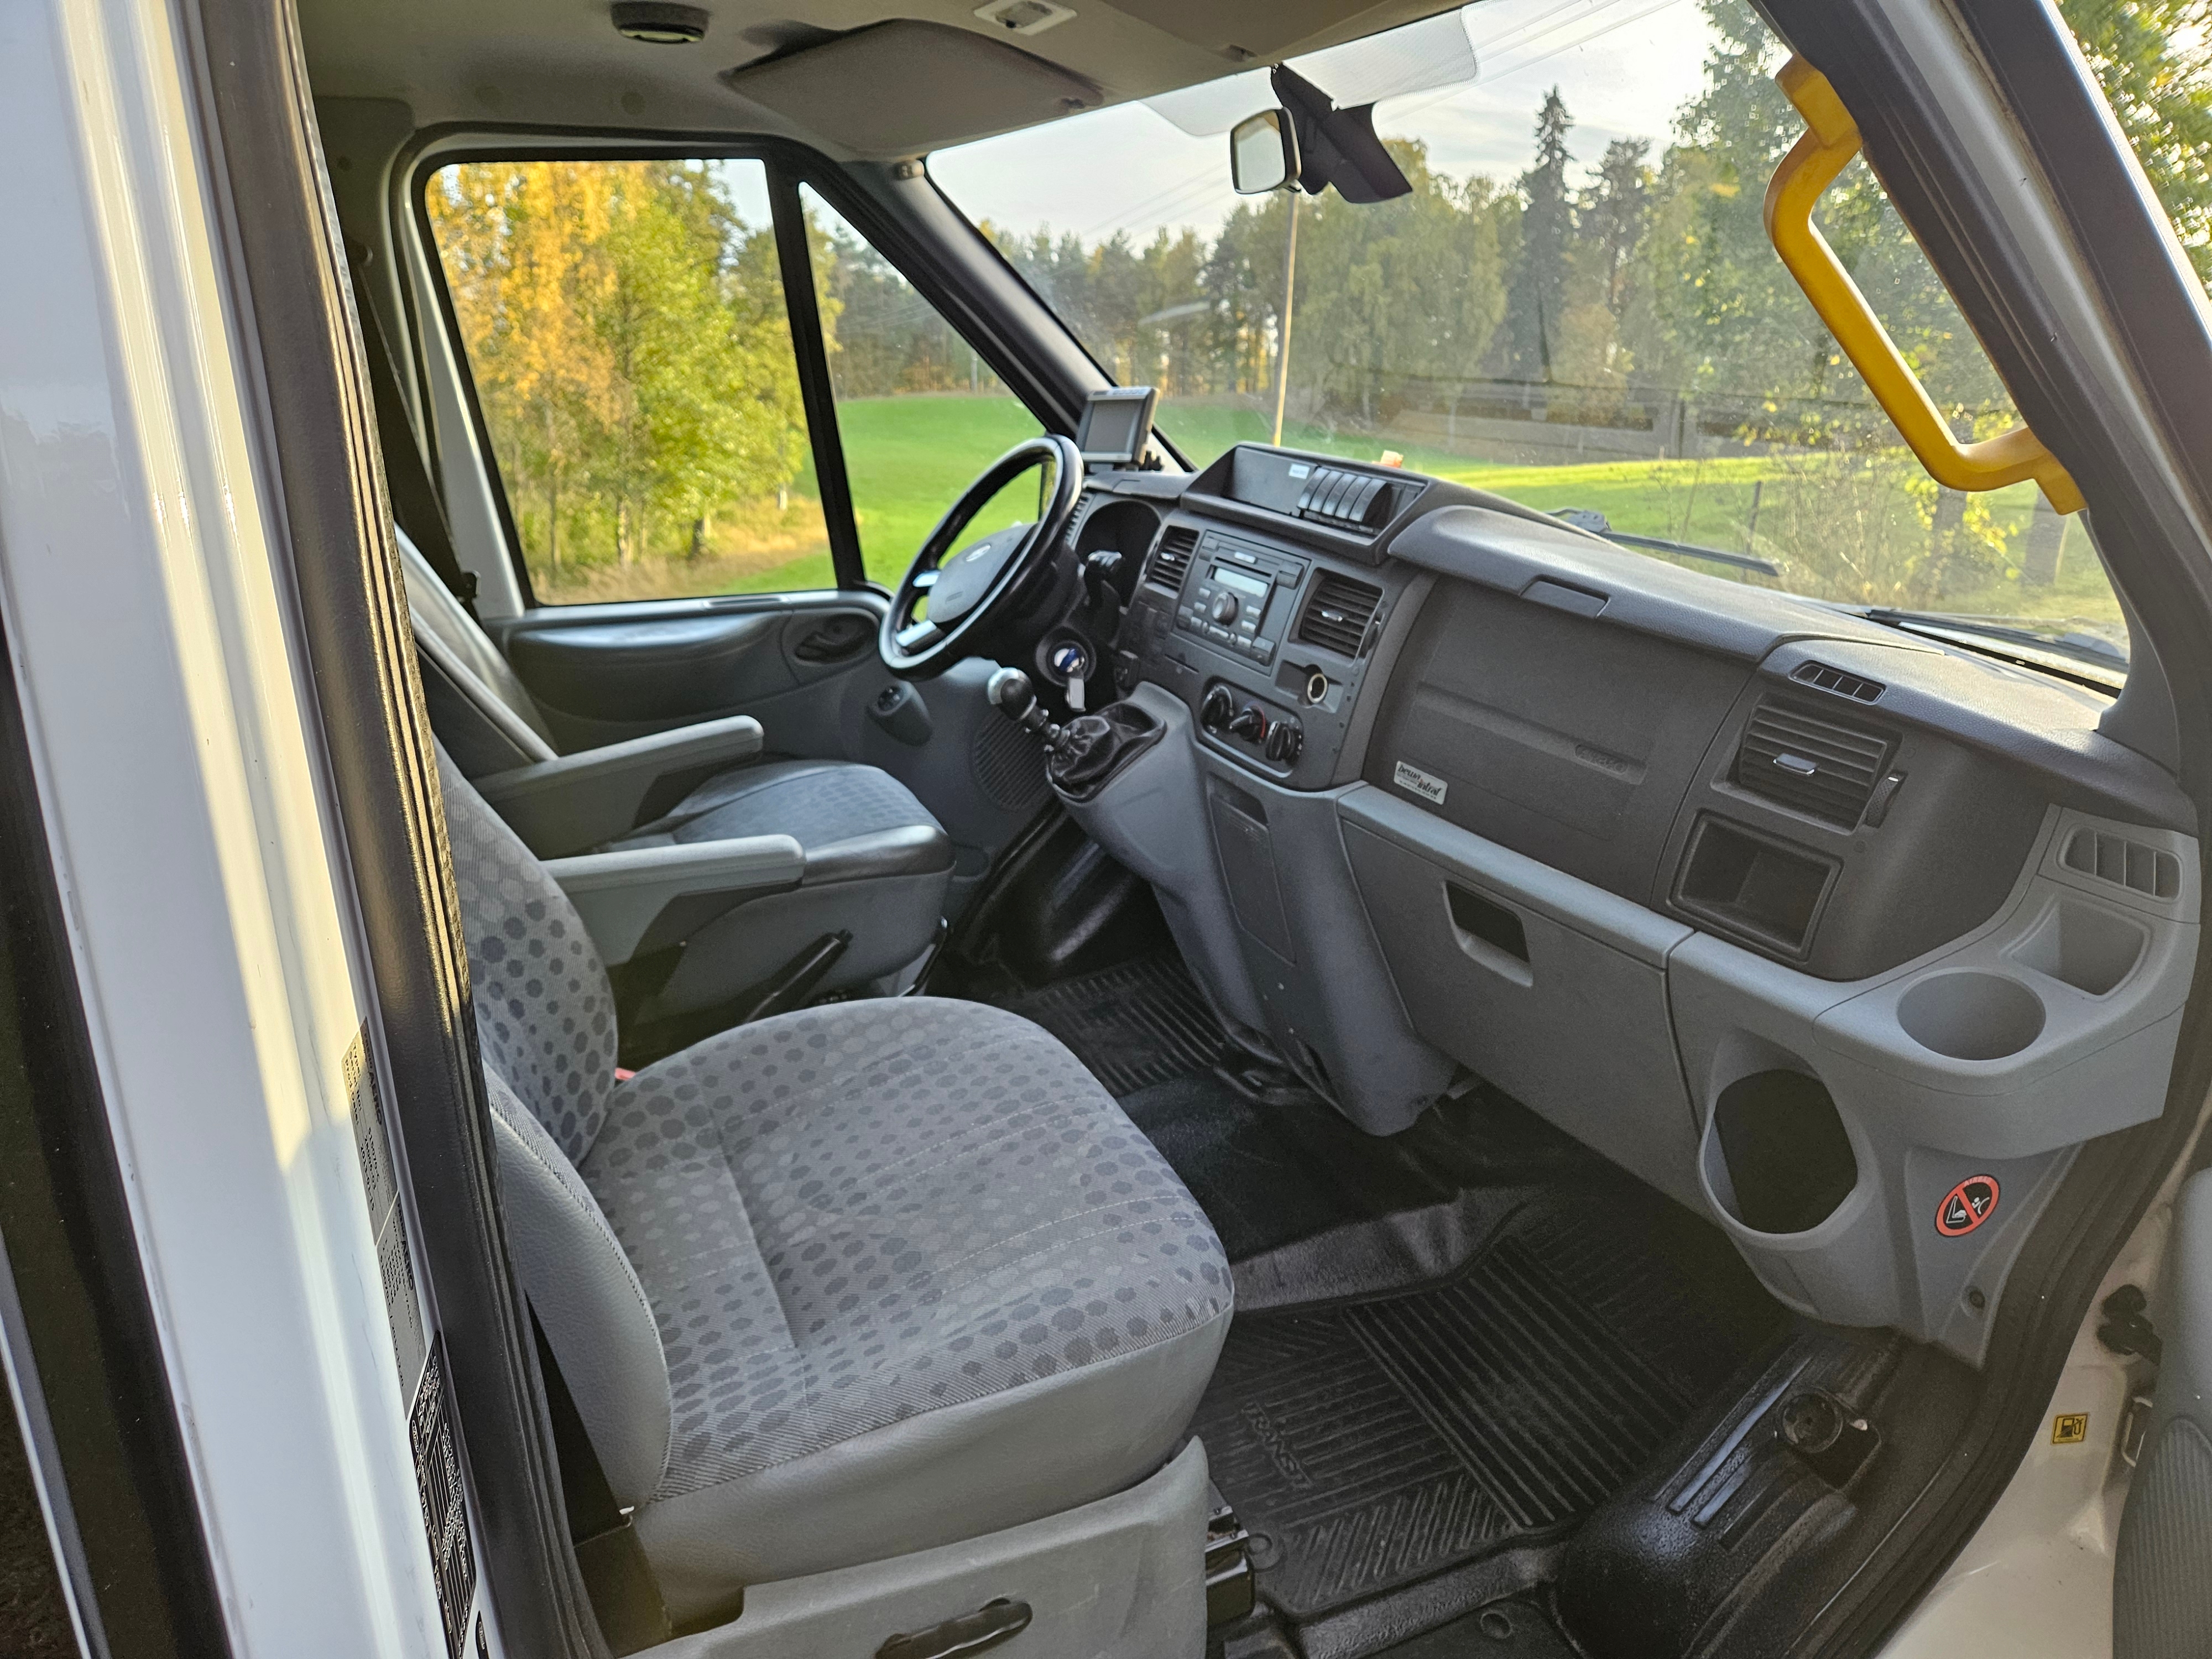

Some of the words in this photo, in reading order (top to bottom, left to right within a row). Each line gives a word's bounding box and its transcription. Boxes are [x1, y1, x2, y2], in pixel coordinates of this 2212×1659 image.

[348, 1052, 357, 1086] Serial
[352, 1044, 361, 1078] Type:
[1964, 1176, 1991, 1187] AIRBAG
